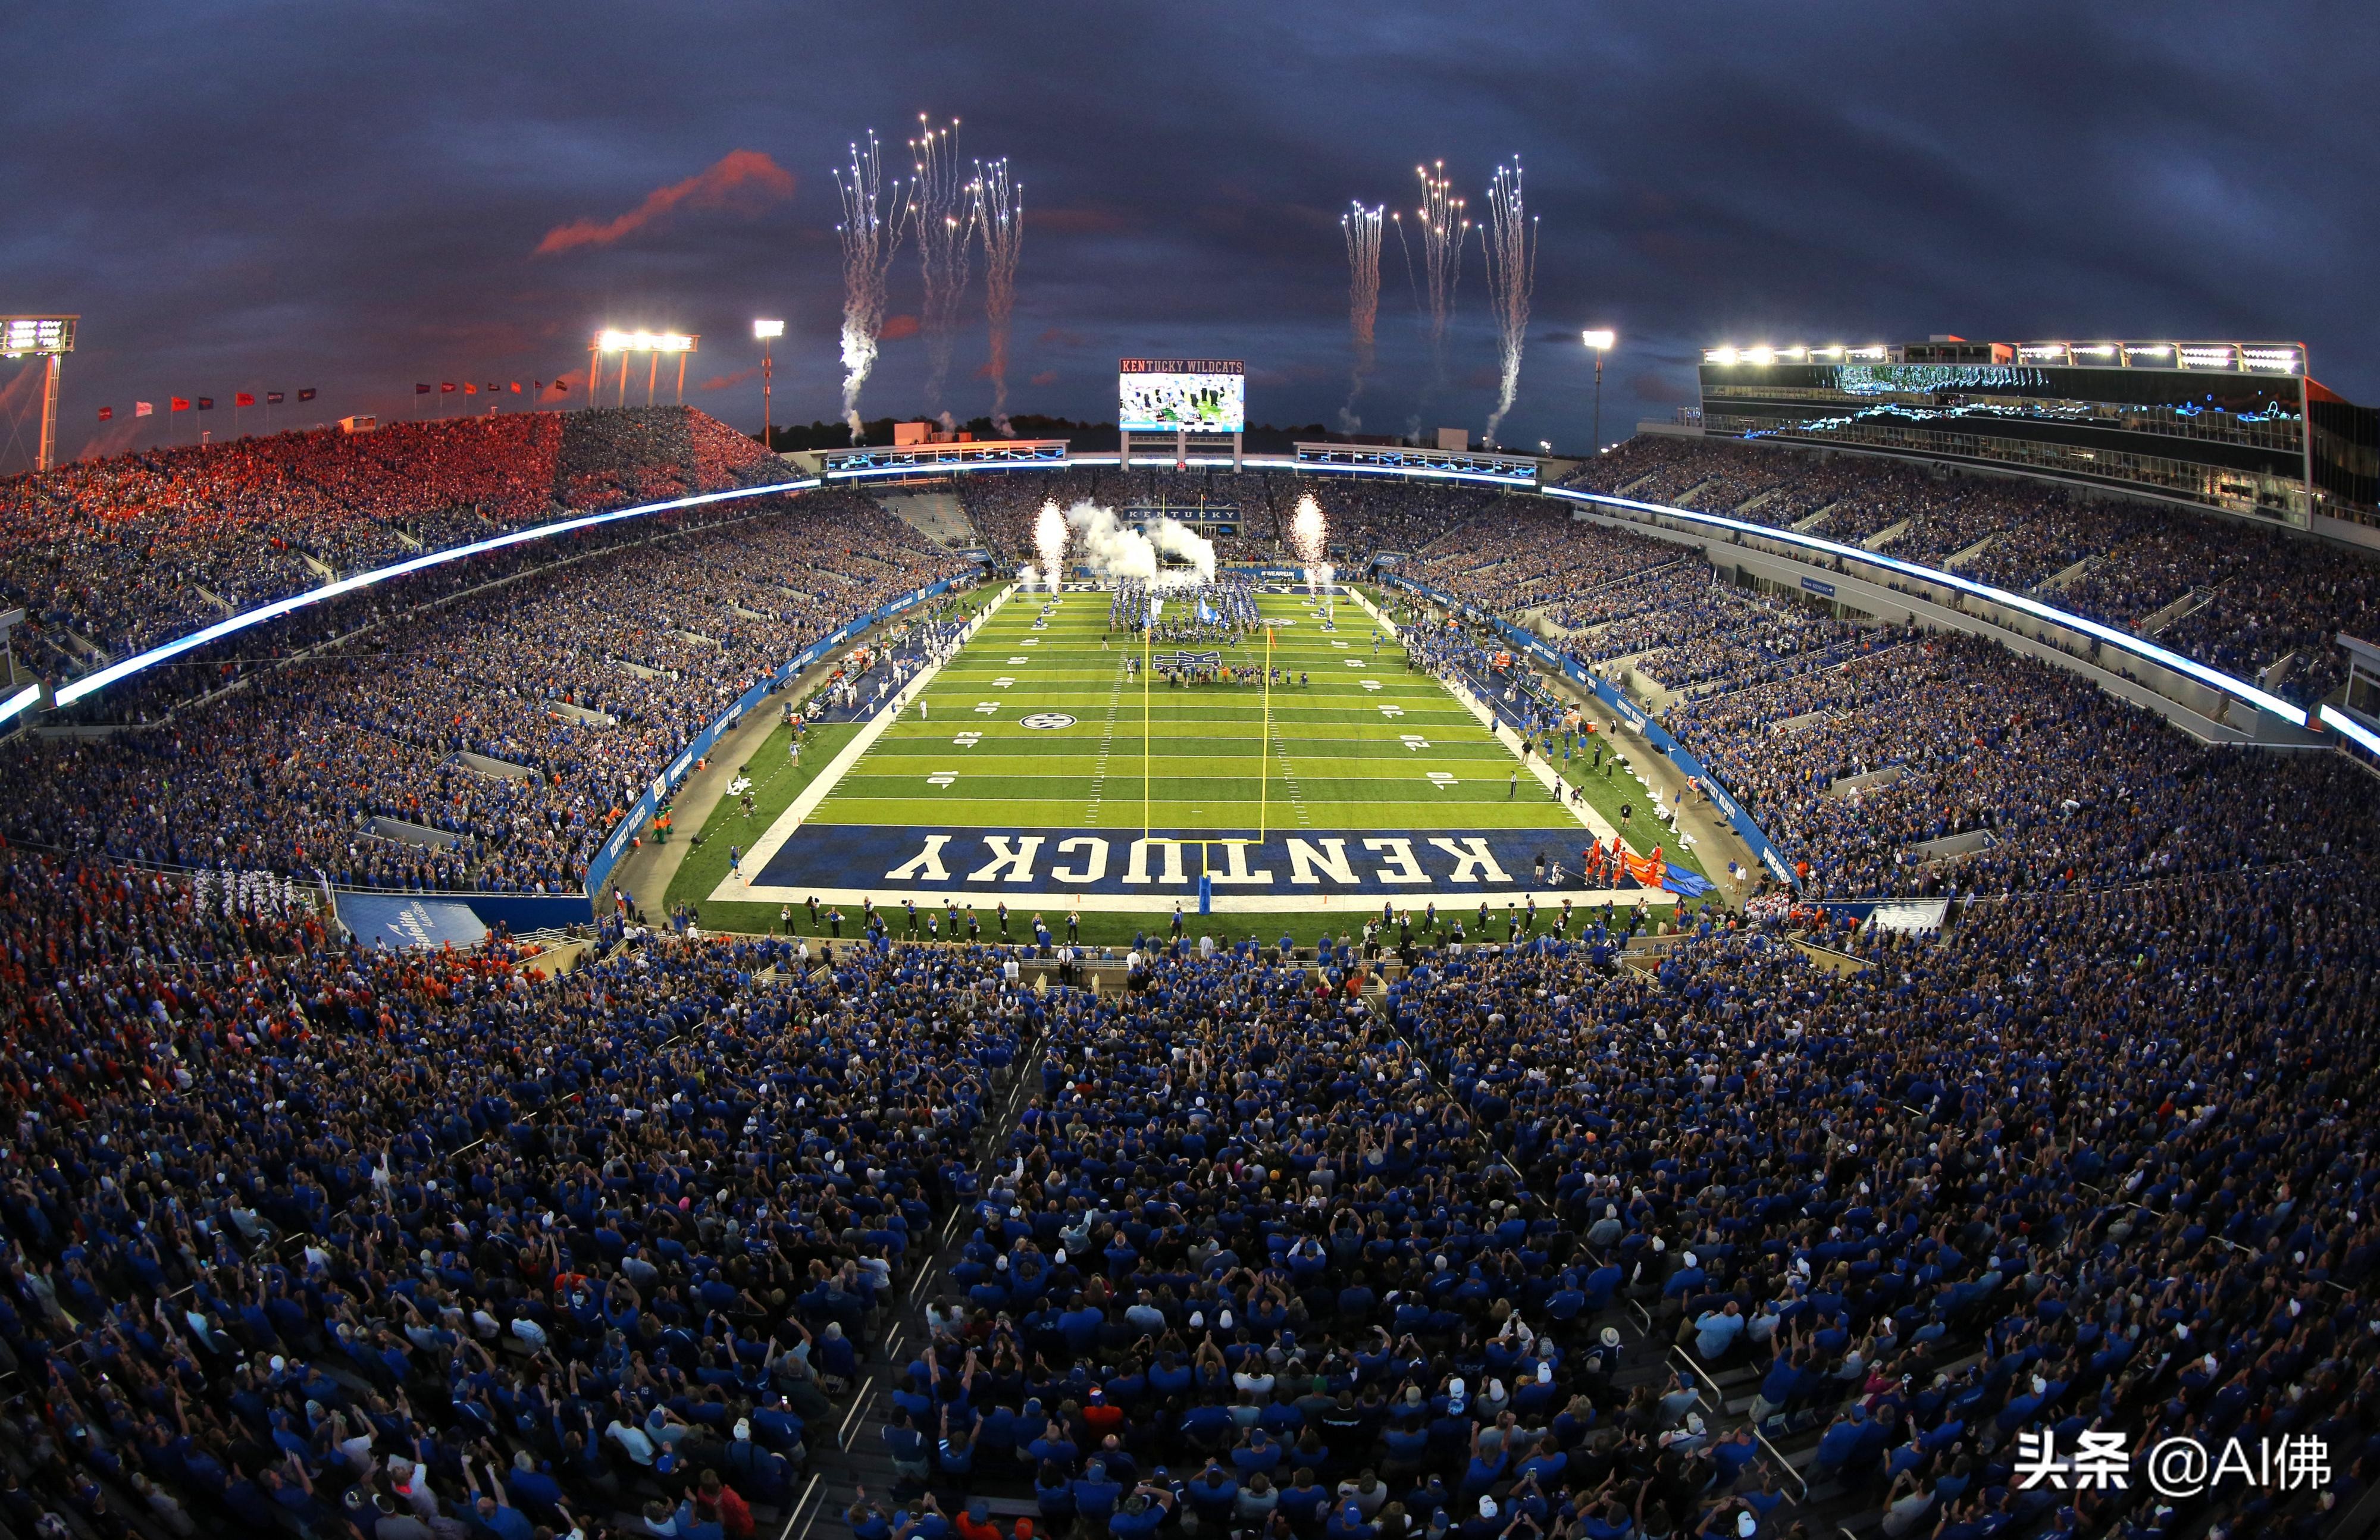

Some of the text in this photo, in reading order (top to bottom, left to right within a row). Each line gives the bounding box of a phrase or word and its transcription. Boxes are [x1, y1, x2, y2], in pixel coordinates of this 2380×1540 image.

[1123, 360, 1242, 373] KENTUCKY WILDCATS
[1129, 510, 1235, 519] KENTUCKY
[953, 731, 983, 745] 20
[1399, 735, 1430, 748] 20
[926, 770, 960, 784] 10
[1426, 771, 1459, 785] 10
[1718, 793, 1736, 819] WILDCATS
[610, 804, 646, 859] KENTUCKY WILDCATS
[885, 835, 1514, 884] KENTUCKY
[410, 901, 436, 928] AutoGlass
